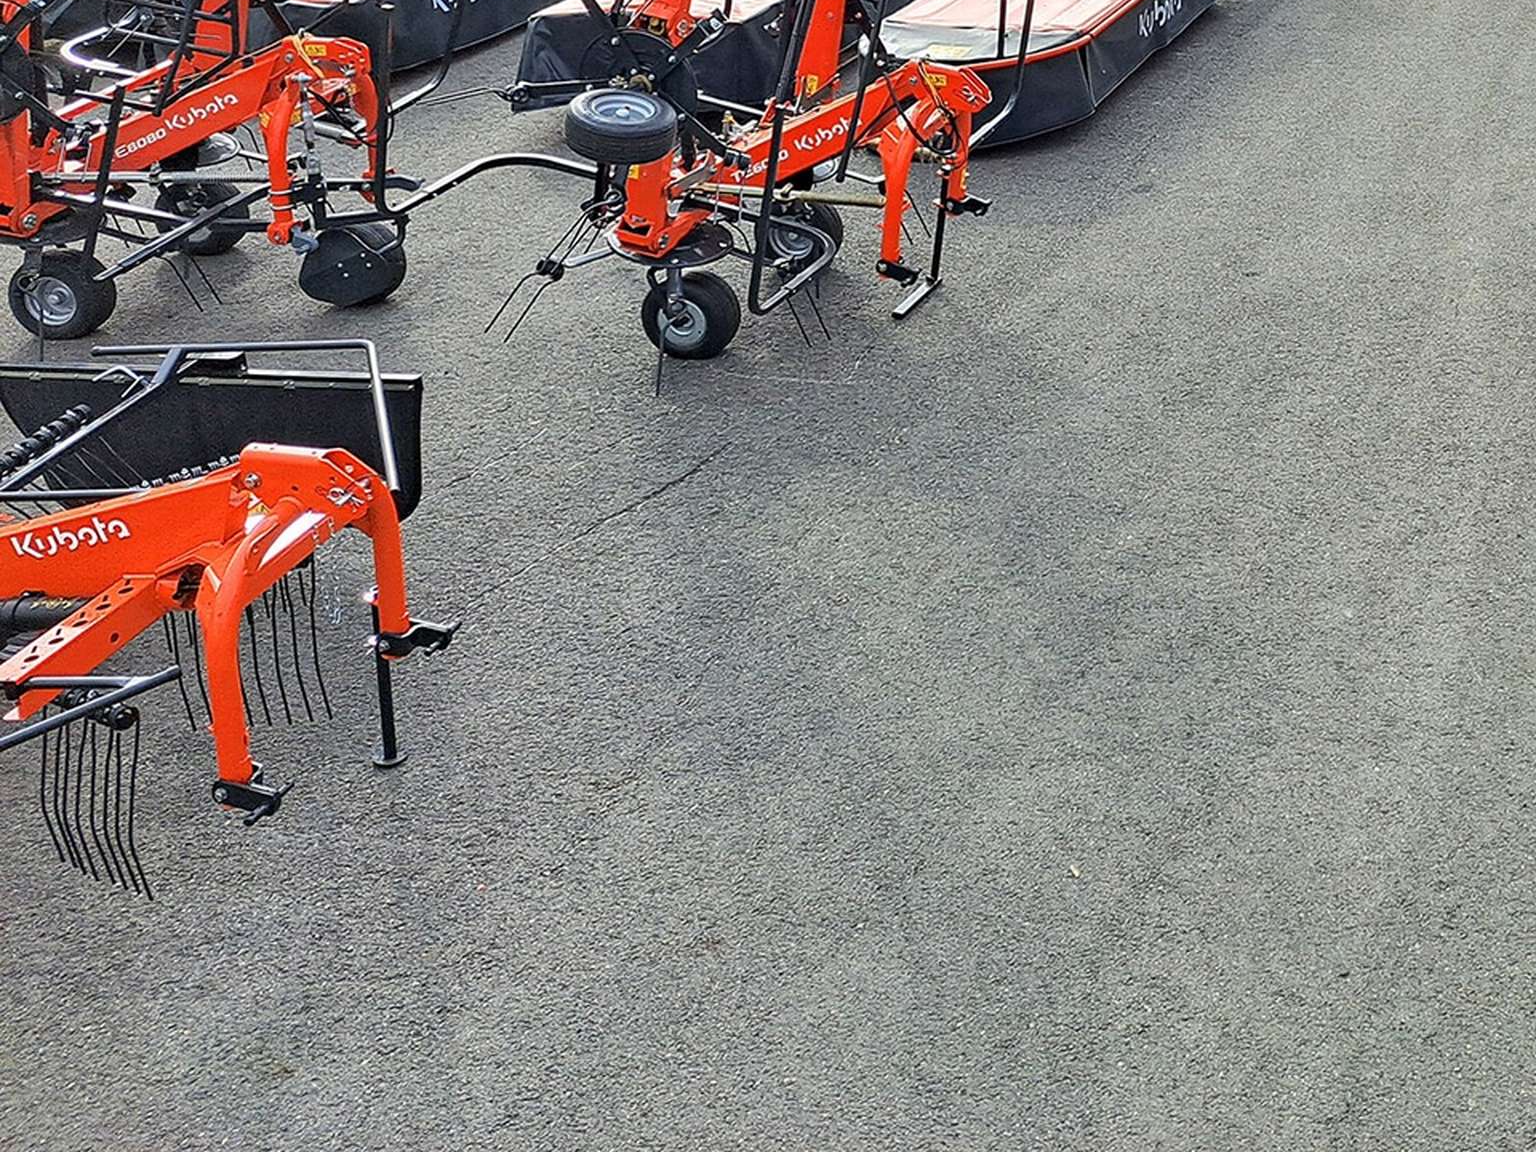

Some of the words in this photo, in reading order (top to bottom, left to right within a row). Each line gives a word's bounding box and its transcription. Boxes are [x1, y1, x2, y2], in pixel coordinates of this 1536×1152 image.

[165, 94, 239, 130] Kubota
[794, 117, 862, 151] Kubot
[10, 516, 131, 558] Kubota
